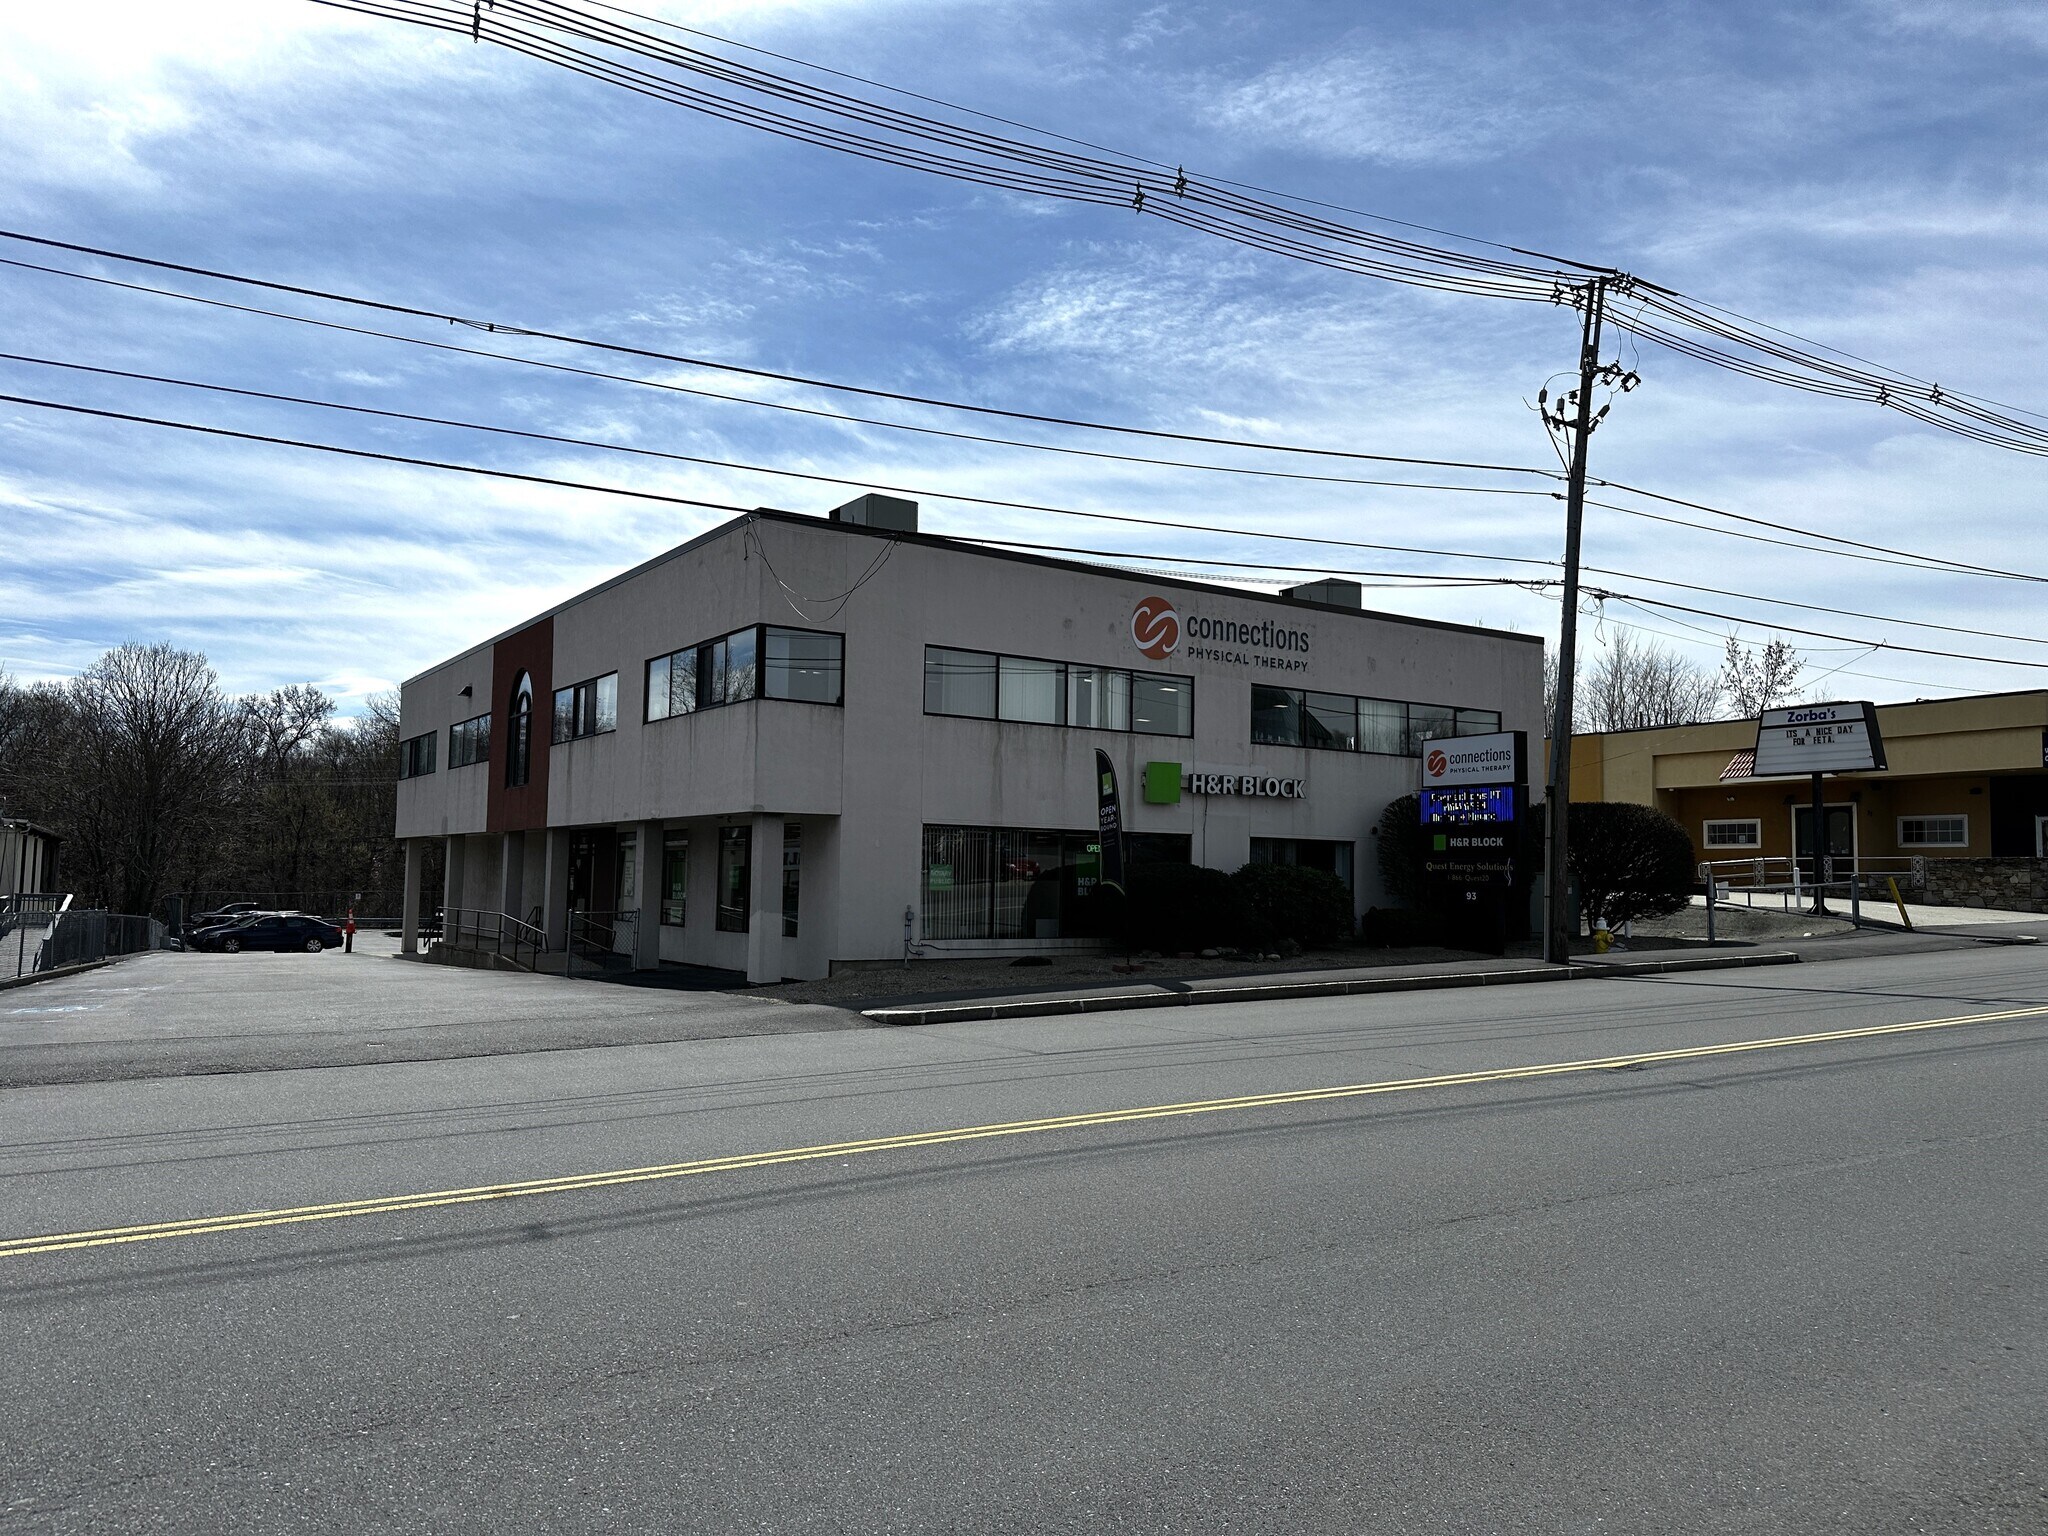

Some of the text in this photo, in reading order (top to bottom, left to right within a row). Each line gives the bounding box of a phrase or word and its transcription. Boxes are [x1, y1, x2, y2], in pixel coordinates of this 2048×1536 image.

[1187, 616, 1309, 652] connections
[1188, 647, 1308, 672] PHYSICAL THERAPY
[1787, 708, 1836, 723] Zorba's
[1786, 725, 1853, 738] ITS A NICE DAY
[1793, 736, 1835, 746] FOR FETA.
[1449, 748, 1511, 765] connections
[1450, 765, 1511, 774] PHYSICAL THERAPY
[1191, 774, 1307, 799] H&R BLOCK
[1100, 804, 1117, 816] OPEN
[1450, 837, 1504, 847] H&R BLOCK
[1426, 861, 1514, 873] Quest Energy Solutions
[1466, 892, 1477, 900] 93
